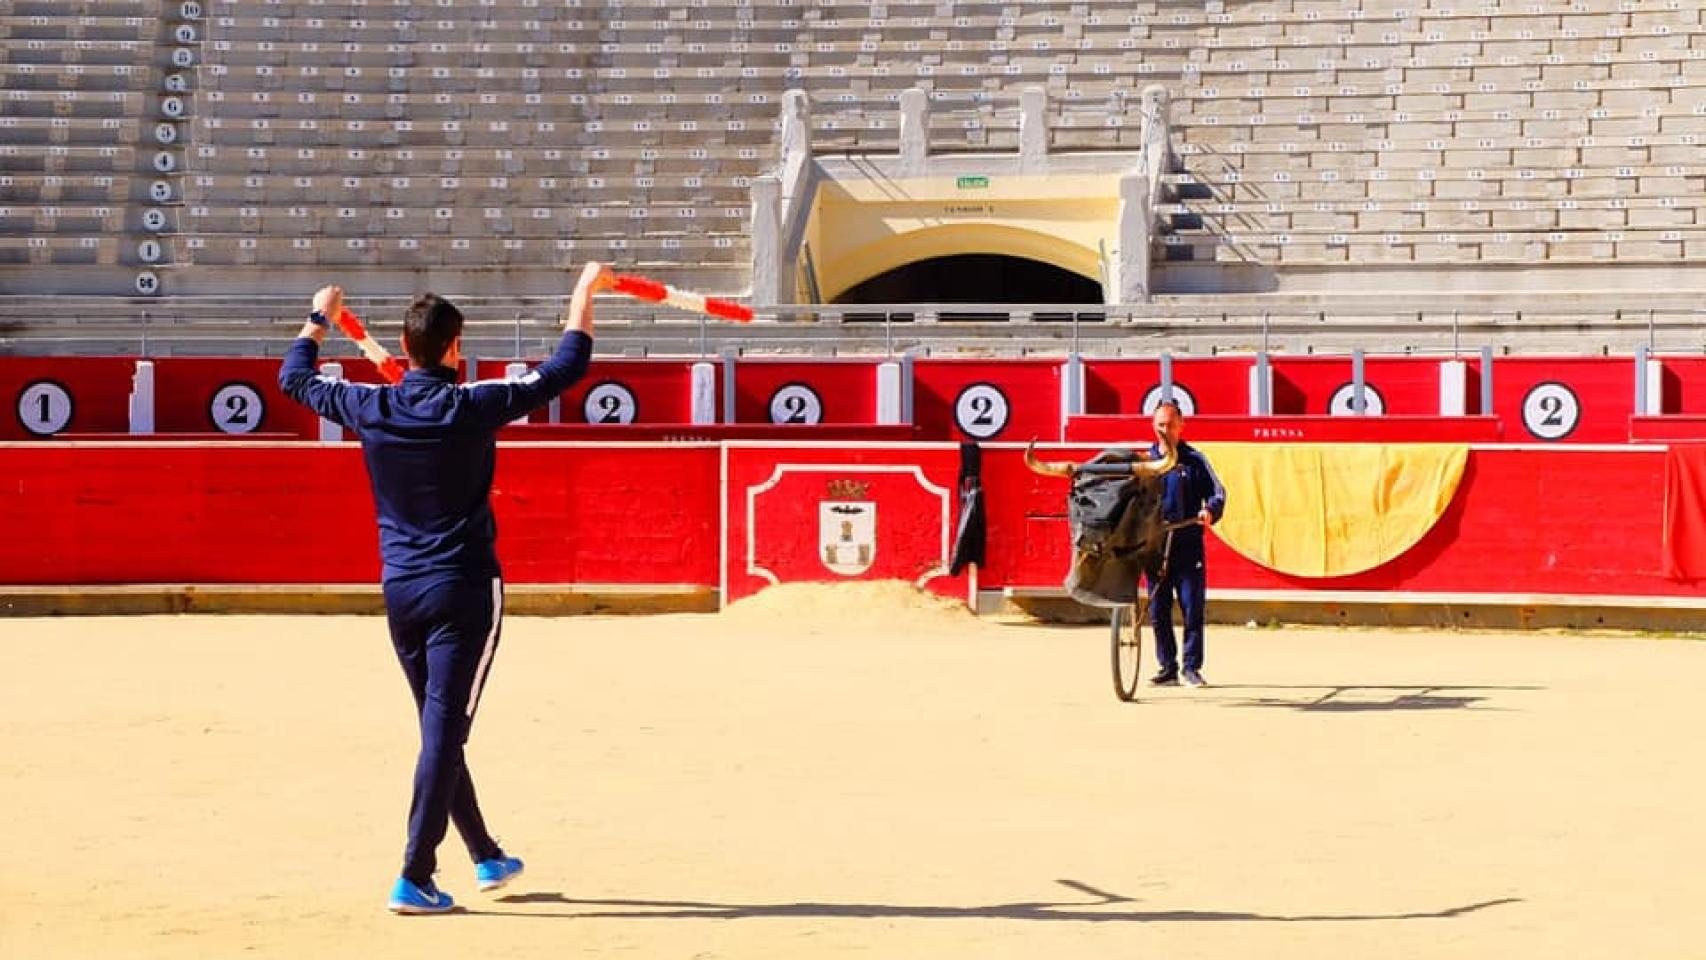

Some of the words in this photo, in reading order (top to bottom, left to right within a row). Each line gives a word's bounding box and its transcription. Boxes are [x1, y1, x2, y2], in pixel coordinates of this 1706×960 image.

[167, 100, 177, 112] 6
[149, 212, 159, 225] 2
[35, 393, 50, 424] 1
[225, 394, 248, 424] 2
[598, 395, 622, 424] 2
[783, 395, 806, 424] 2
[970, 396, 994, 425] 2
[1540, 396, 1563, 426] 2
[1253, 427, 1305, 438] PRENSA
